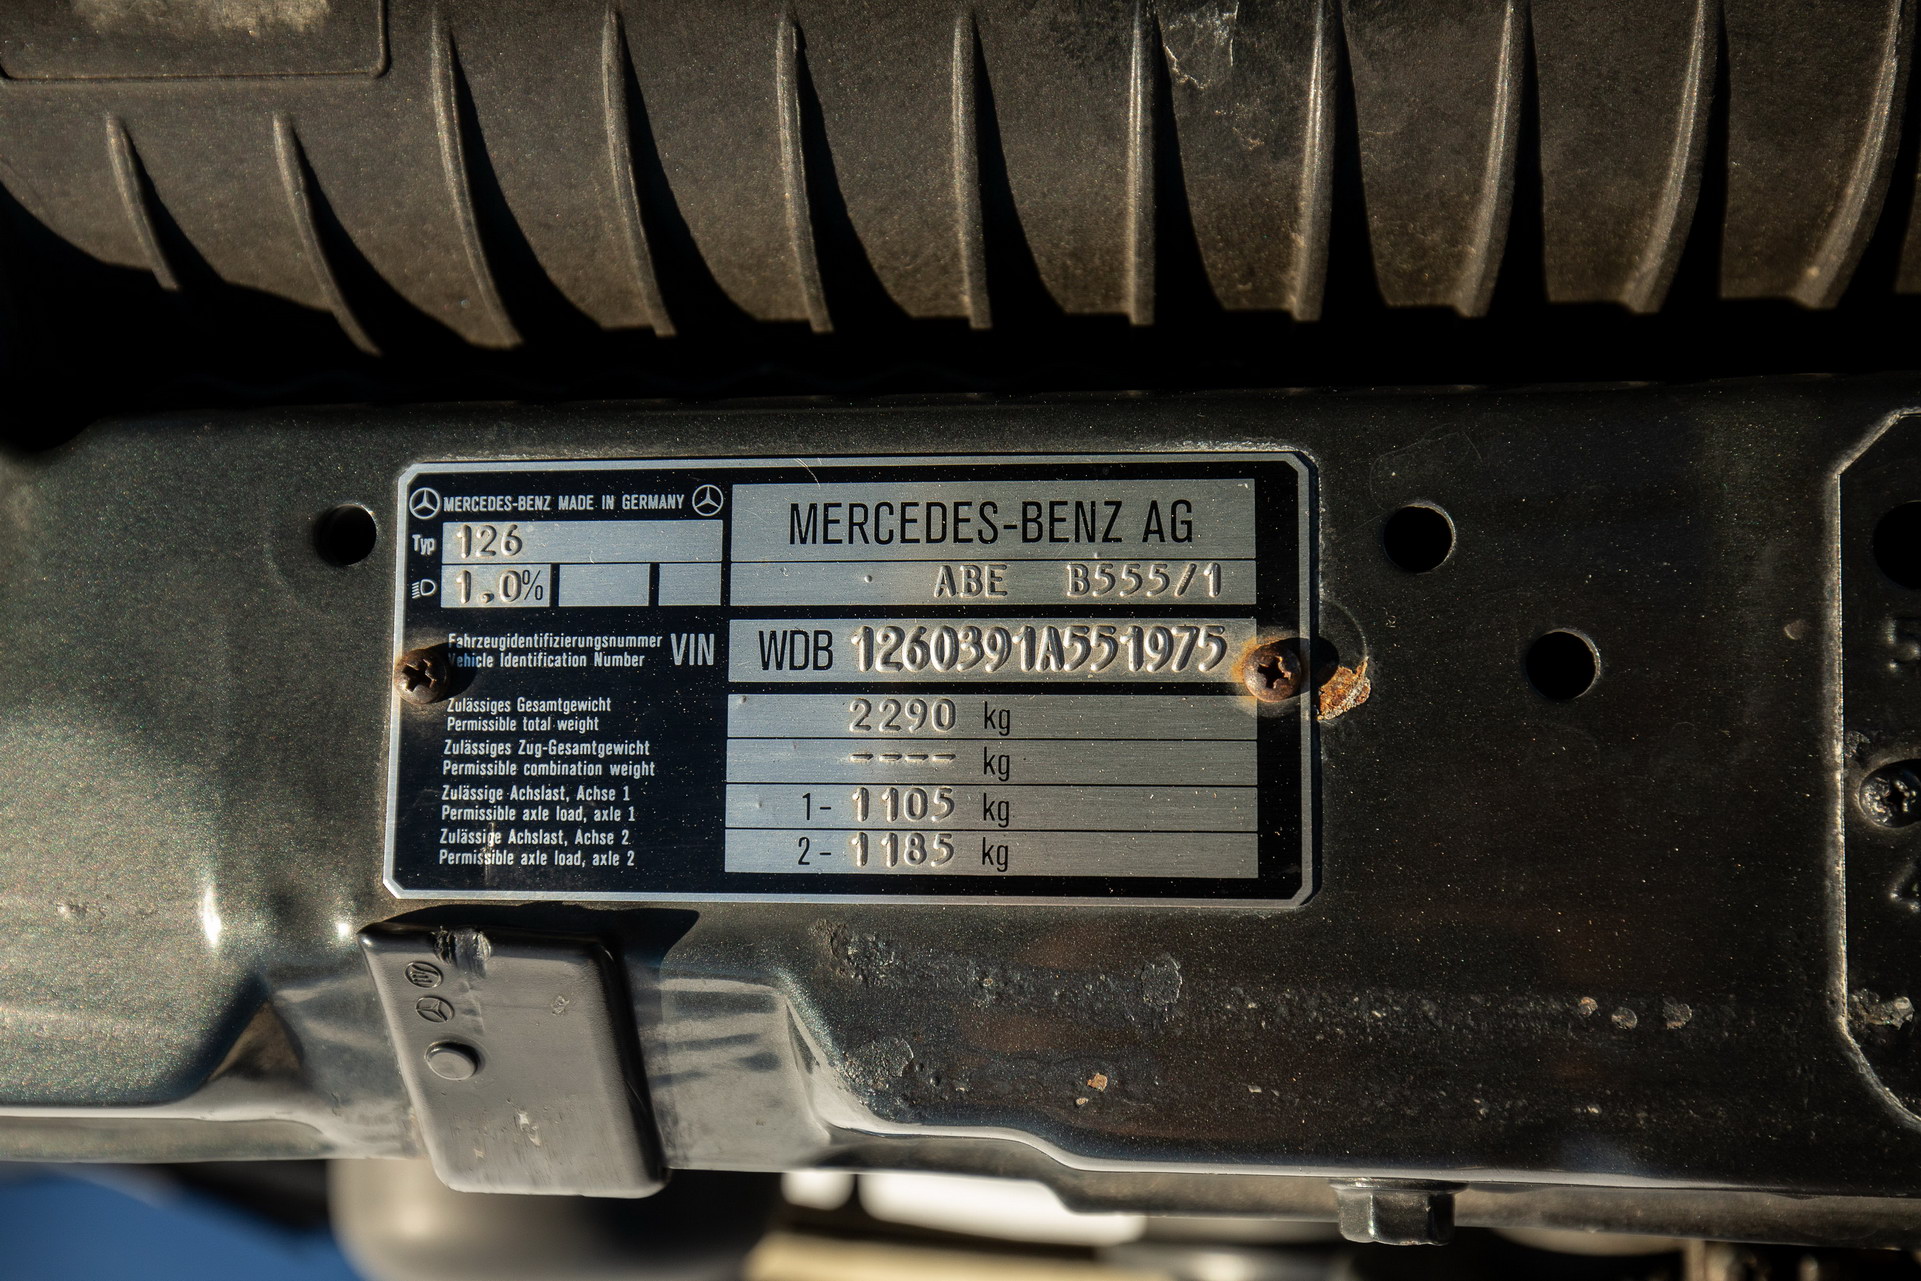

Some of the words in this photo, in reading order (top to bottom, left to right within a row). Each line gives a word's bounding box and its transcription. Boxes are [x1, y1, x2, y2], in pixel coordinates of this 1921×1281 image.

[443, 495, 551, 513] MERCEDES-BENZ
[558, 495, 594, 511] MADE
[602, 495, 614, 510] IN
[622, 493, 684, 510] GERMANY
[789, 500, 1123, 545] MERCEDES-BENZ
[1142, 499, 1194, 543] AG
[411, 534, 435, 556] Typ
[456, 524, 523, 558] 126
[934, 563, 1008, 598] ABE
[1067, 562, 1223, 597] B555/1
[448, 632, 663, 652] Fahrzeugidentifizierungsnummer
[670, 633, 715, 666] VIN
[758, 629, 833, 671] WDB
[850, 624, 1228, 673] 1260391A551975
[447, 653, 494, 668] Vehicle
[500, 652, 587, 668] Identification
[594, 652, 645, 668] Number
[447, 697, 511, 714] Zulässiges
[516, 697, 611, 714] Gesamtgewicht
[447, 717, 517, 731] Permissible
[522, 718, 551, 731] total
[557, 717, 599, 733] weight
[848, 697, 958, 733] 2290
[983, 701, 1011, 736] kg
[444, 739, 511, 756] Zulässiges
[518, 739, 650, 757] Zug-Gesamtgewicht
[443, 760, 517, 776] Permissible
[523, 760, 602, 776] combination
[609, 760, 655, 779] weight
[983, 746, 1011, 781] kg
[441, 784, 503, 803] Zulässige
[510, 784, 570, 802] Achslast,
[577, 784, 616, 801] Achse
[622, 786, 630, 800] 1
[441, 804, 516, 821] Permissible
[522, 806, 549, 820] axle
[556, 806, 587, 823] load,
[594, 806, 621, 821] axle
[628, 807, 636, 821] 1
[850, 787, 955, 822] 1105
[982, 792, 1010, 827] kg
[440, 828, 501, 846] Zulässige
[508, 828, 568, 846] Achslast,
[575, 828, 615, 844] Achse
[622, 828, 630, 844] 2
[439, 849, 514, 865] Permissible
[520, 849, 547, 865] axle
[554, 849, 586, 866] load,
[592, 849, 620, 865] axle
[627, 851, 635, 865] 2
[850, 832, 955, 867] 1185
[981, 836, 1009, 871] kg
